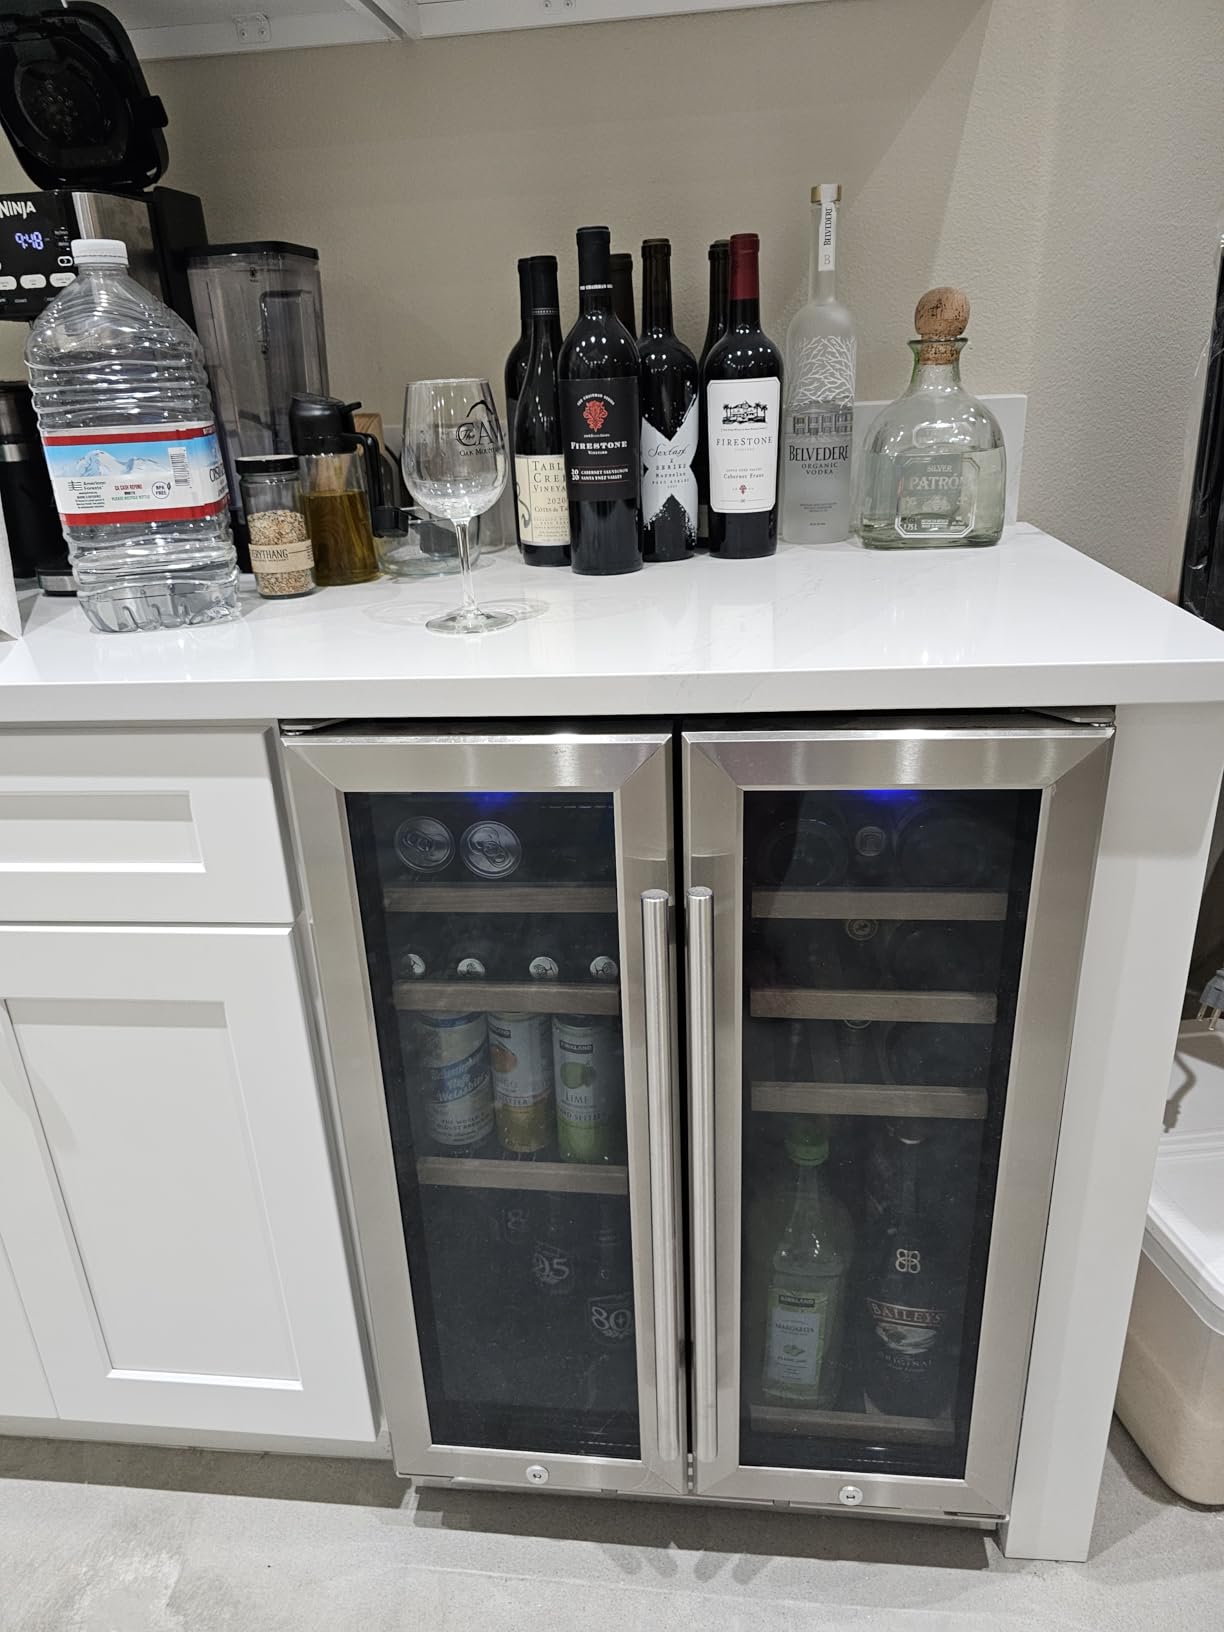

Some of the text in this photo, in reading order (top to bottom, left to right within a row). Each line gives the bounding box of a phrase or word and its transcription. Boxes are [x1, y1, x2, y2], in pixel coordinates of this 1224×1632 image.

[0, 201, 37, 219] NINJA
[570, 440, 628, 450] FIRESTONE
[716, 436, 773, 446] FIRESTONE
[532, 460, 563, 471] TABL
[801, 461, 839, 469] ORGANIC
[910, 473, 966, 490] PATRÓ
[533, 485, 567, 493] VINEYA
[591, 1305, 633, 1331] 80
[871, 1303, 943, 1323] BAILEYS
